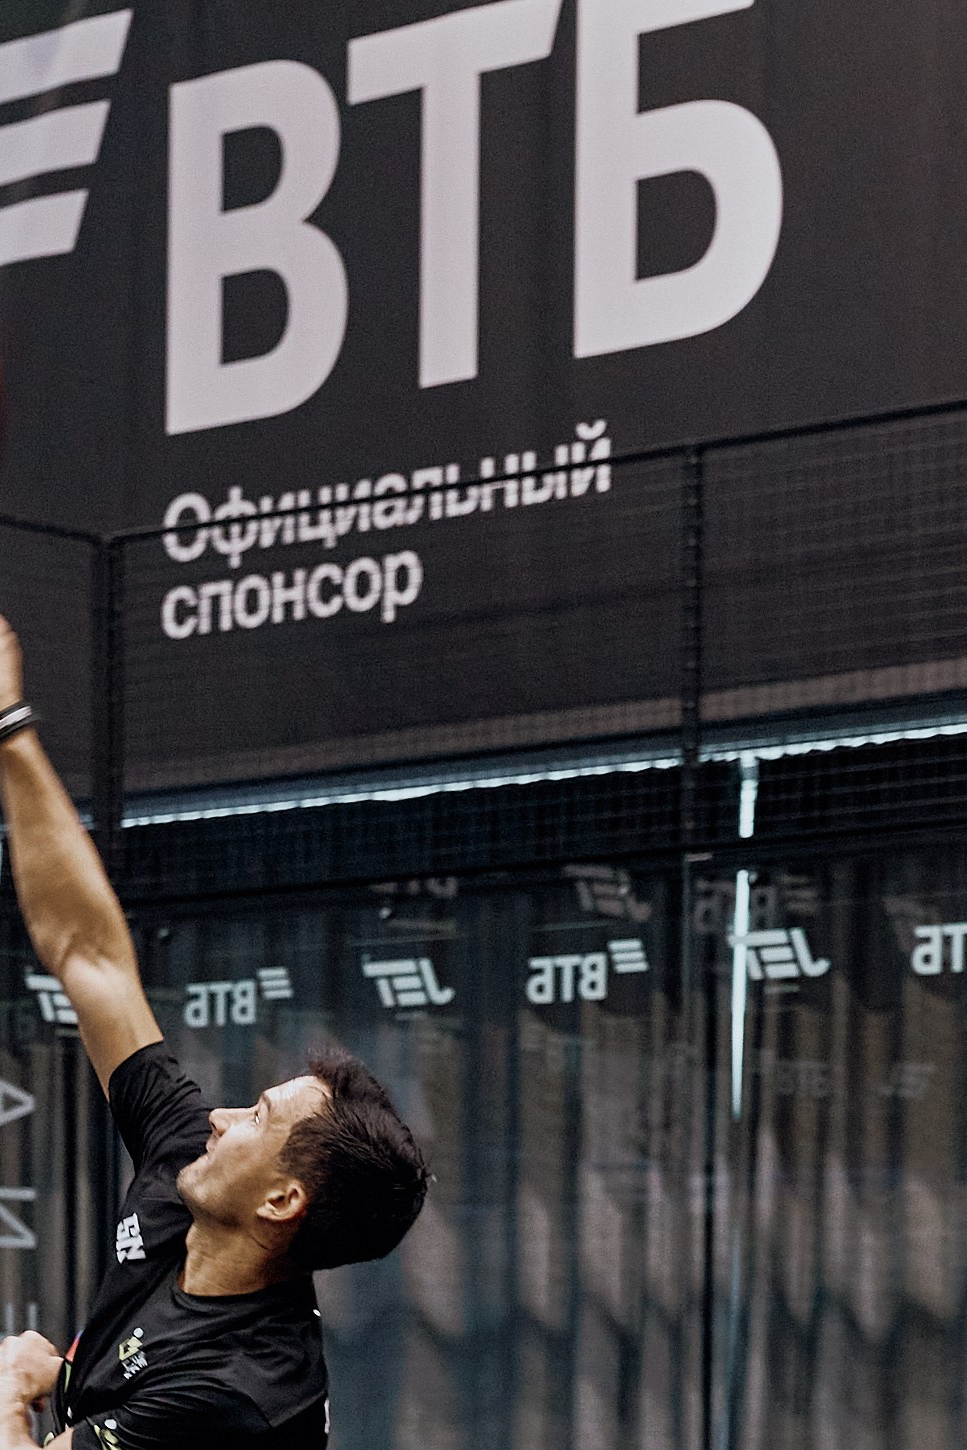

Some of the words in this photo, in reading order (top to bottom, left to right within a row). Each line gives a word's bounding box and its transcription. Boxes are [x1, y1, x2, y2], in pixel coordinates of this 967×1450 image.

[166, 0, 784, 434] ВТБ
[162, 418, 612, 568] Официальный
[161, 549, 424, 640] спонсор
